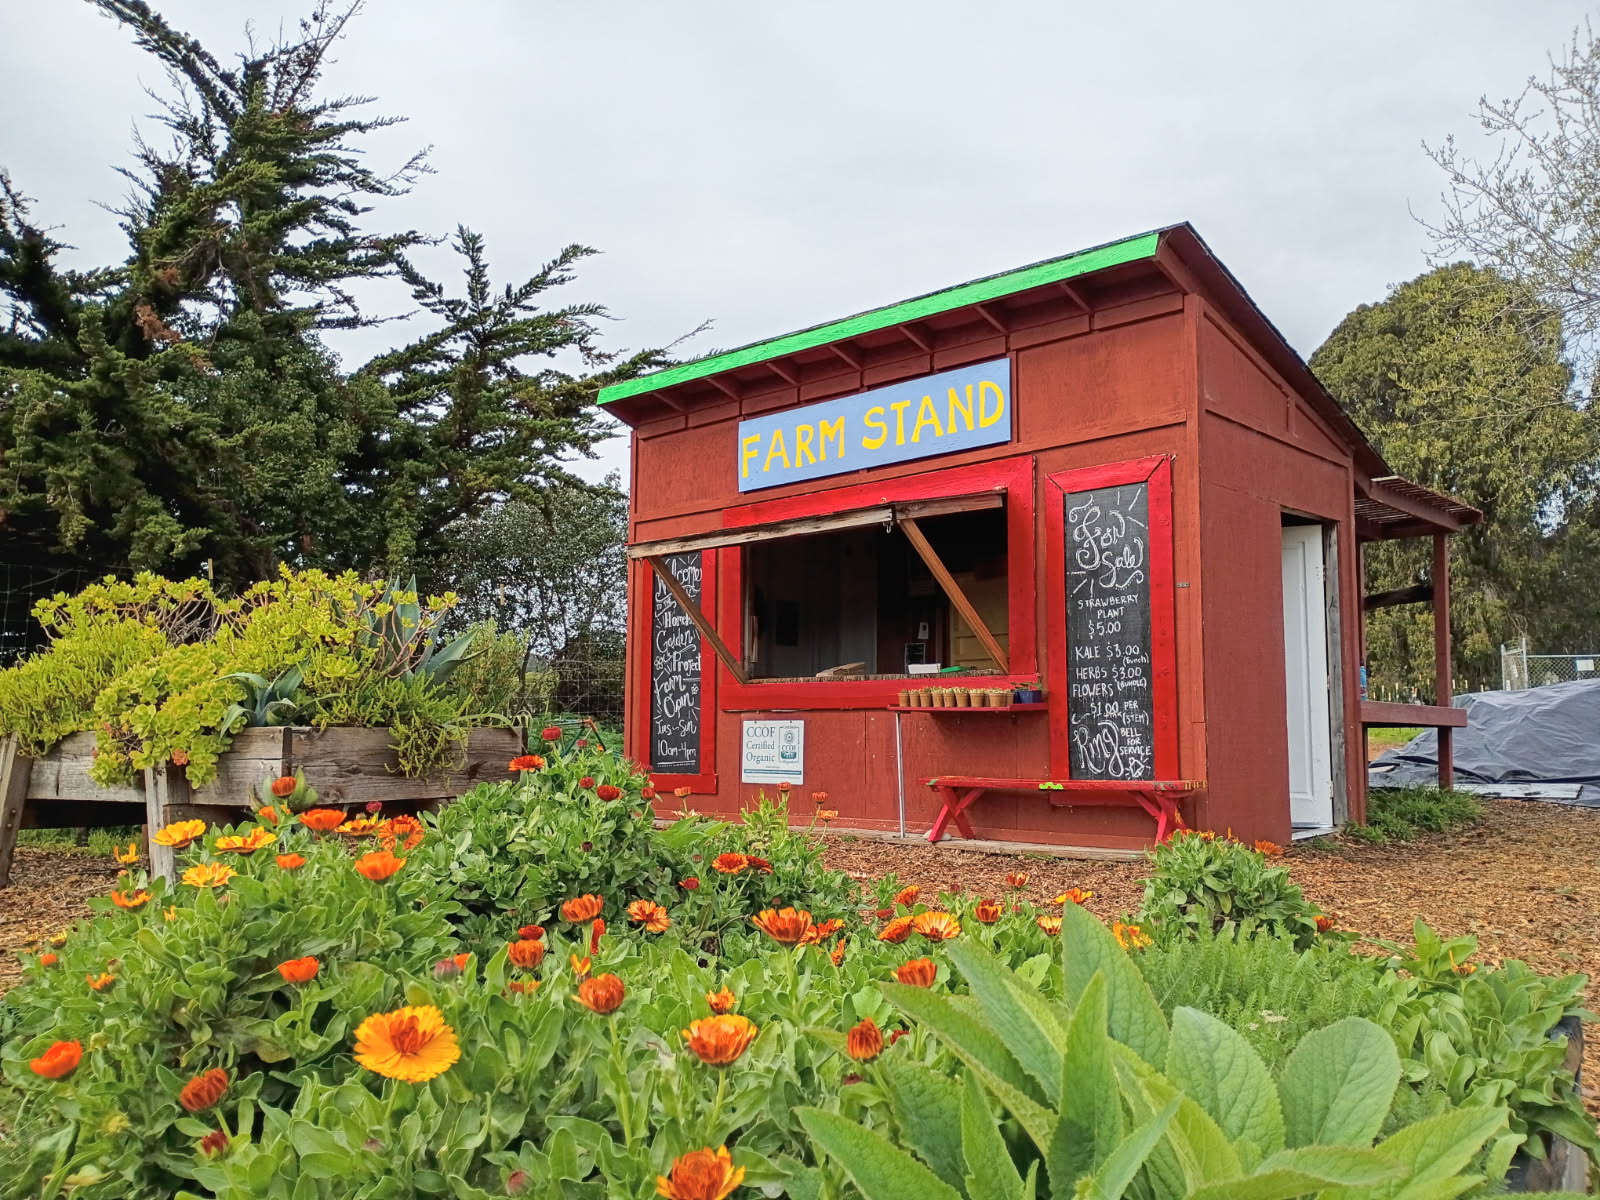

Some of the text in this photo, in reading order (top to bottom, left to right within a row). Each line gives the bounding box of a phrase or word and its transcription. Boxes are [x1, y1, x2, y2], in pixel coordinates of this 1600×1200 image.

[742, 380, 1005, 478] FARM STAND
[1073, 505, 1126, 570] For
[1099, 537, 1144, 588] Sale
[1077, 594, 1138, 609] STRAWBERRY
[1097, 606, 1124, 619] PLANT
[1088, 619, 1121, 640] $5.00
[1075, 641, 1140, 661] KALE $3.00
[1076, 664, 1142, 682] HERBS $3.00
[1073, 683, 1114, 698] FLOWERS
[1123, 700, 1139, 710] PER
[746, 726, 776, 737] CCOF
[1120, 727, 1142, 738] BELL
[746, 740, 775, 750] Certified
[1073, 720, 1124, 777] Ring
[1127, 737, 1142, 746] FOR
[746, 751, 775, 764] Organic
[1120, 746, 1151, 756] SERVICE
